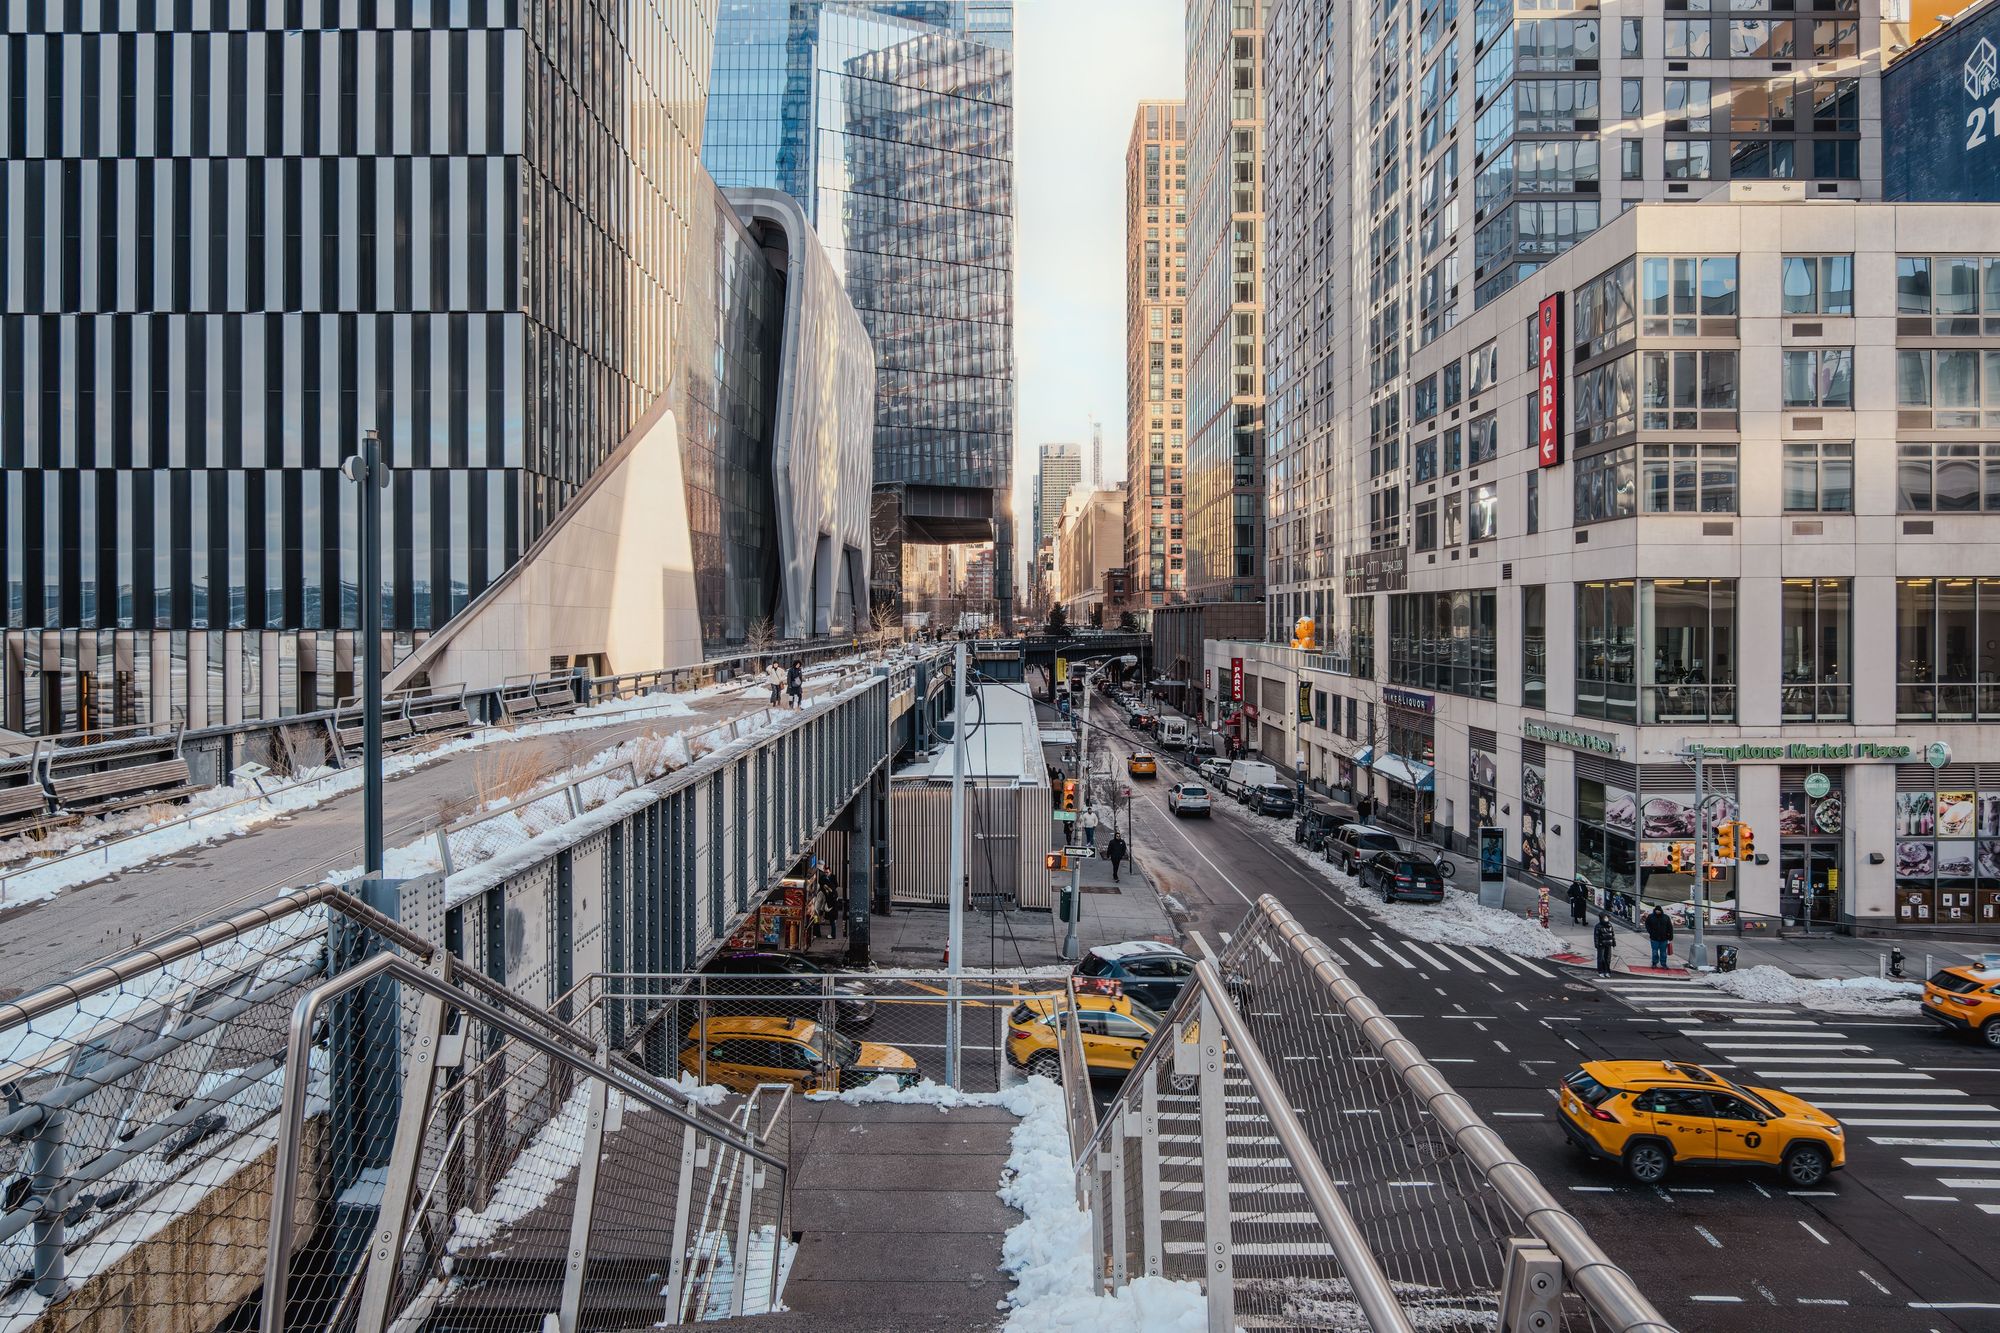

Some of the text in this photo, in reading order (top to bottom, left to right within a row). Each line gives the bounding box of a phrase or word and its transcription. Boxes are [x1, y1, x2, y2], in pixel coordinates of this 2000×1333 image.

[1543, 335, 1554, 432] PARK
[1403, 697, 1425, 708] LIQUOR
[1690, 743, 1784, 761] Hamptons
[1790, 743, 1854, 758] Market
[1860, 743, 1911, 758] Place
